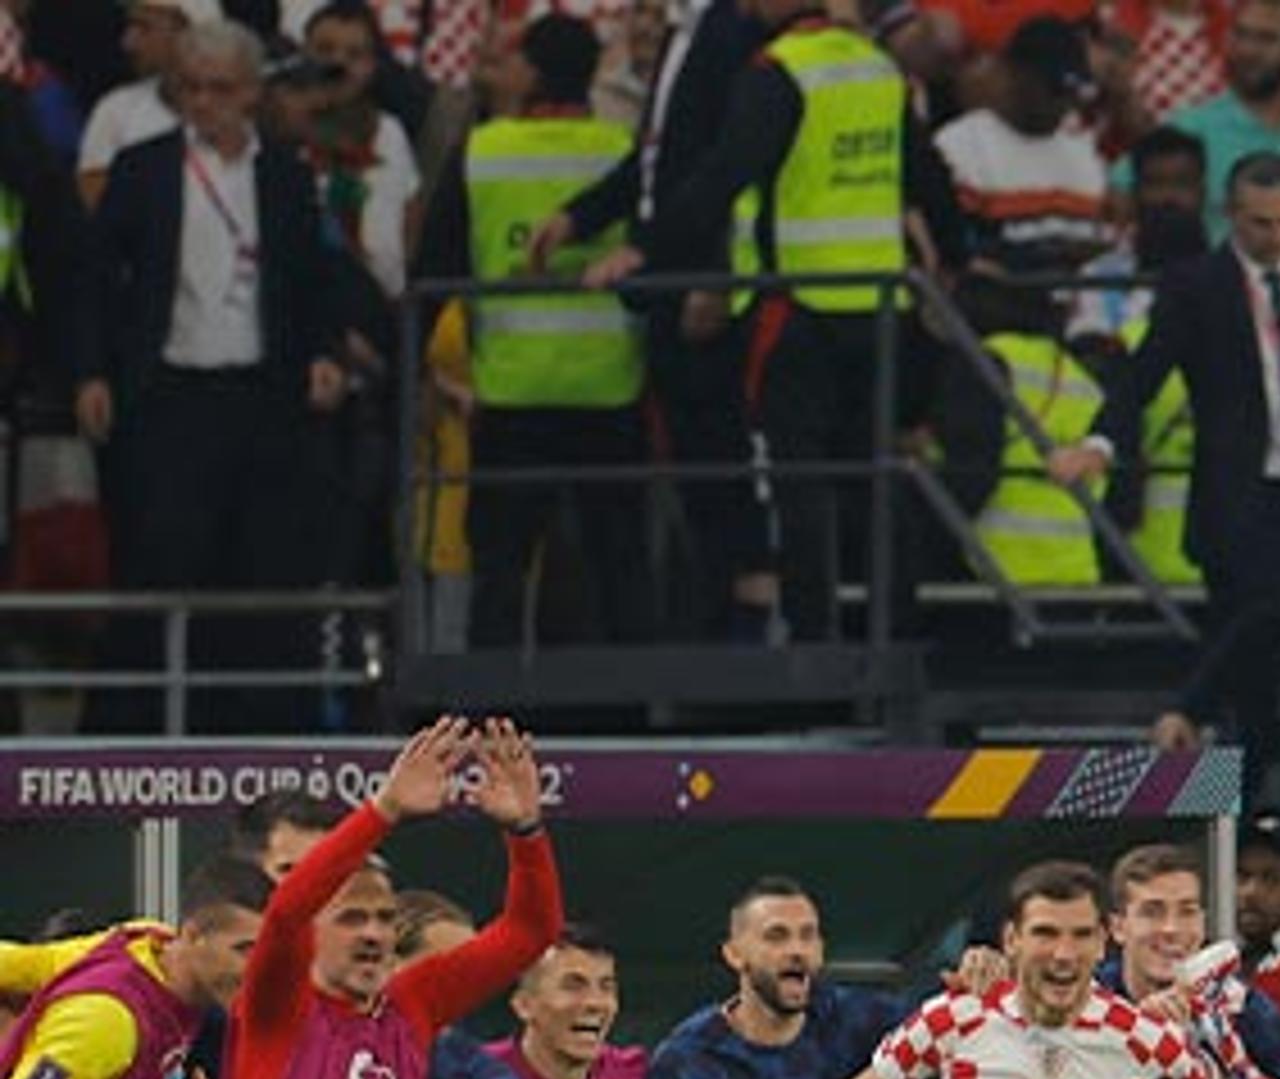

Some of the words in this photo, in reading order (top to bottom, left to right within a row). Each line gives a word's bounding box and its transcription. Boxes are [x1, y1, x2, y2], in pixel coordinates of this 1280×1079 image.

[20, 767, 95, 805] FIFA
[100, 767, 227, 805] WORLD
[232, 766, 301, 805] CUP
